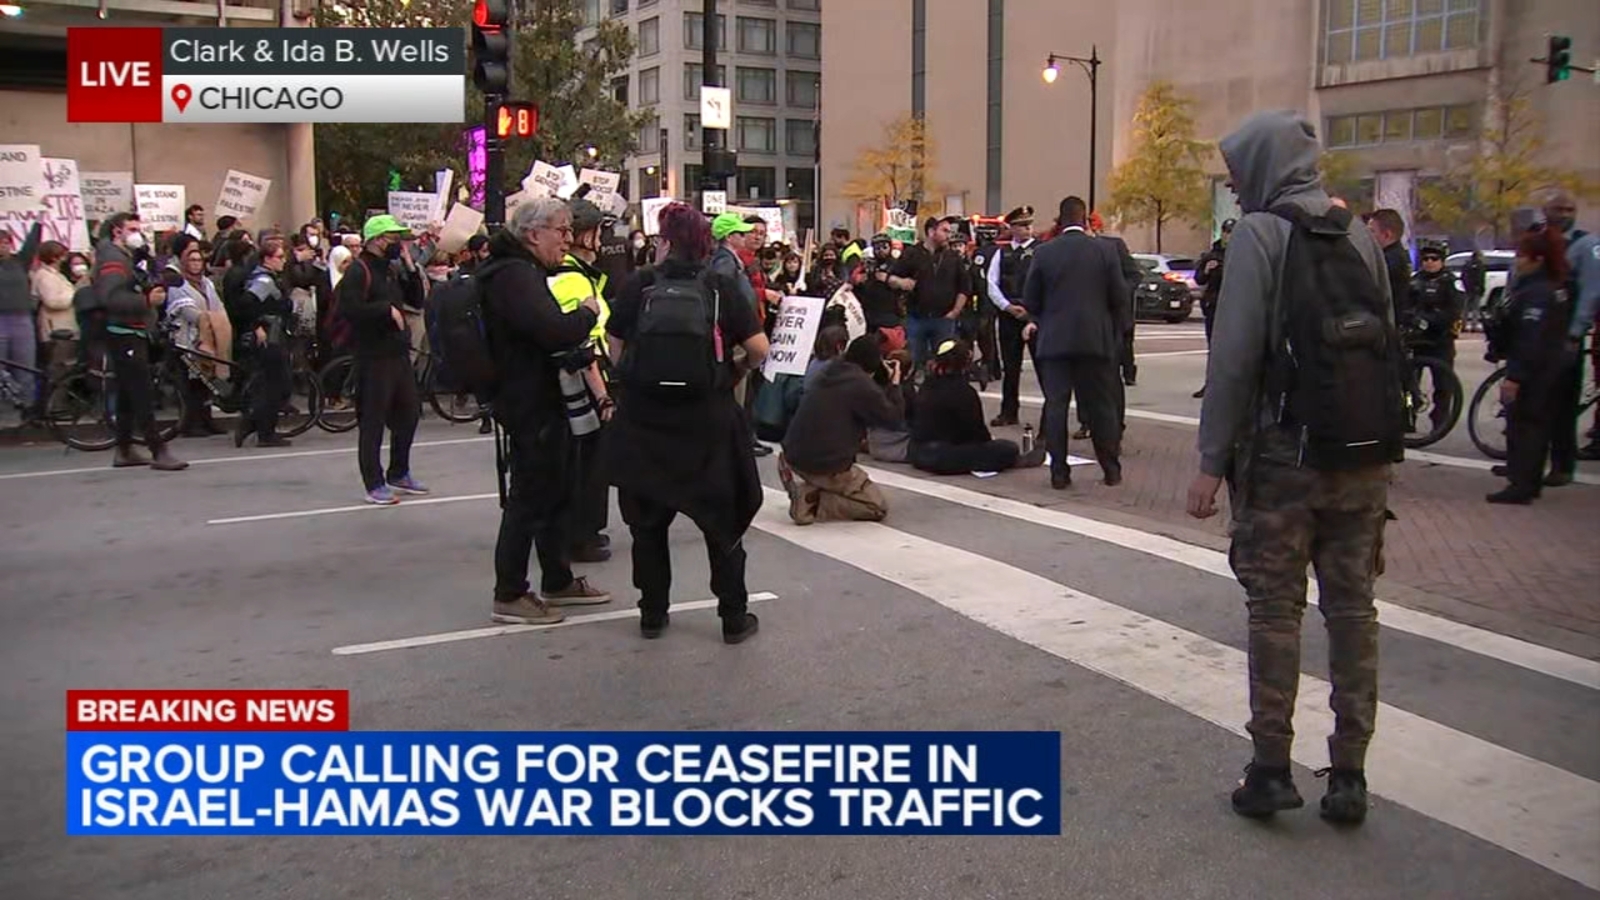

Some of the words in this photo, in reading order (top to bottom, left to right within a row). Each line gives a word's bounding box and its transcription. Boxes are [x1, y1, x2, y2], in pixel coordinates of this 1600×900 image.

[518, 109, 528, 134] 8
[139, 190, 152, 199] WE
[154, 190, 178, 199] STAND
[705, 194, 724, 204] ONE
[601, 244, 626, 255] POLICE
[775, 315, 806, 330] EVER
[769, 349, 798, 364] NOW
